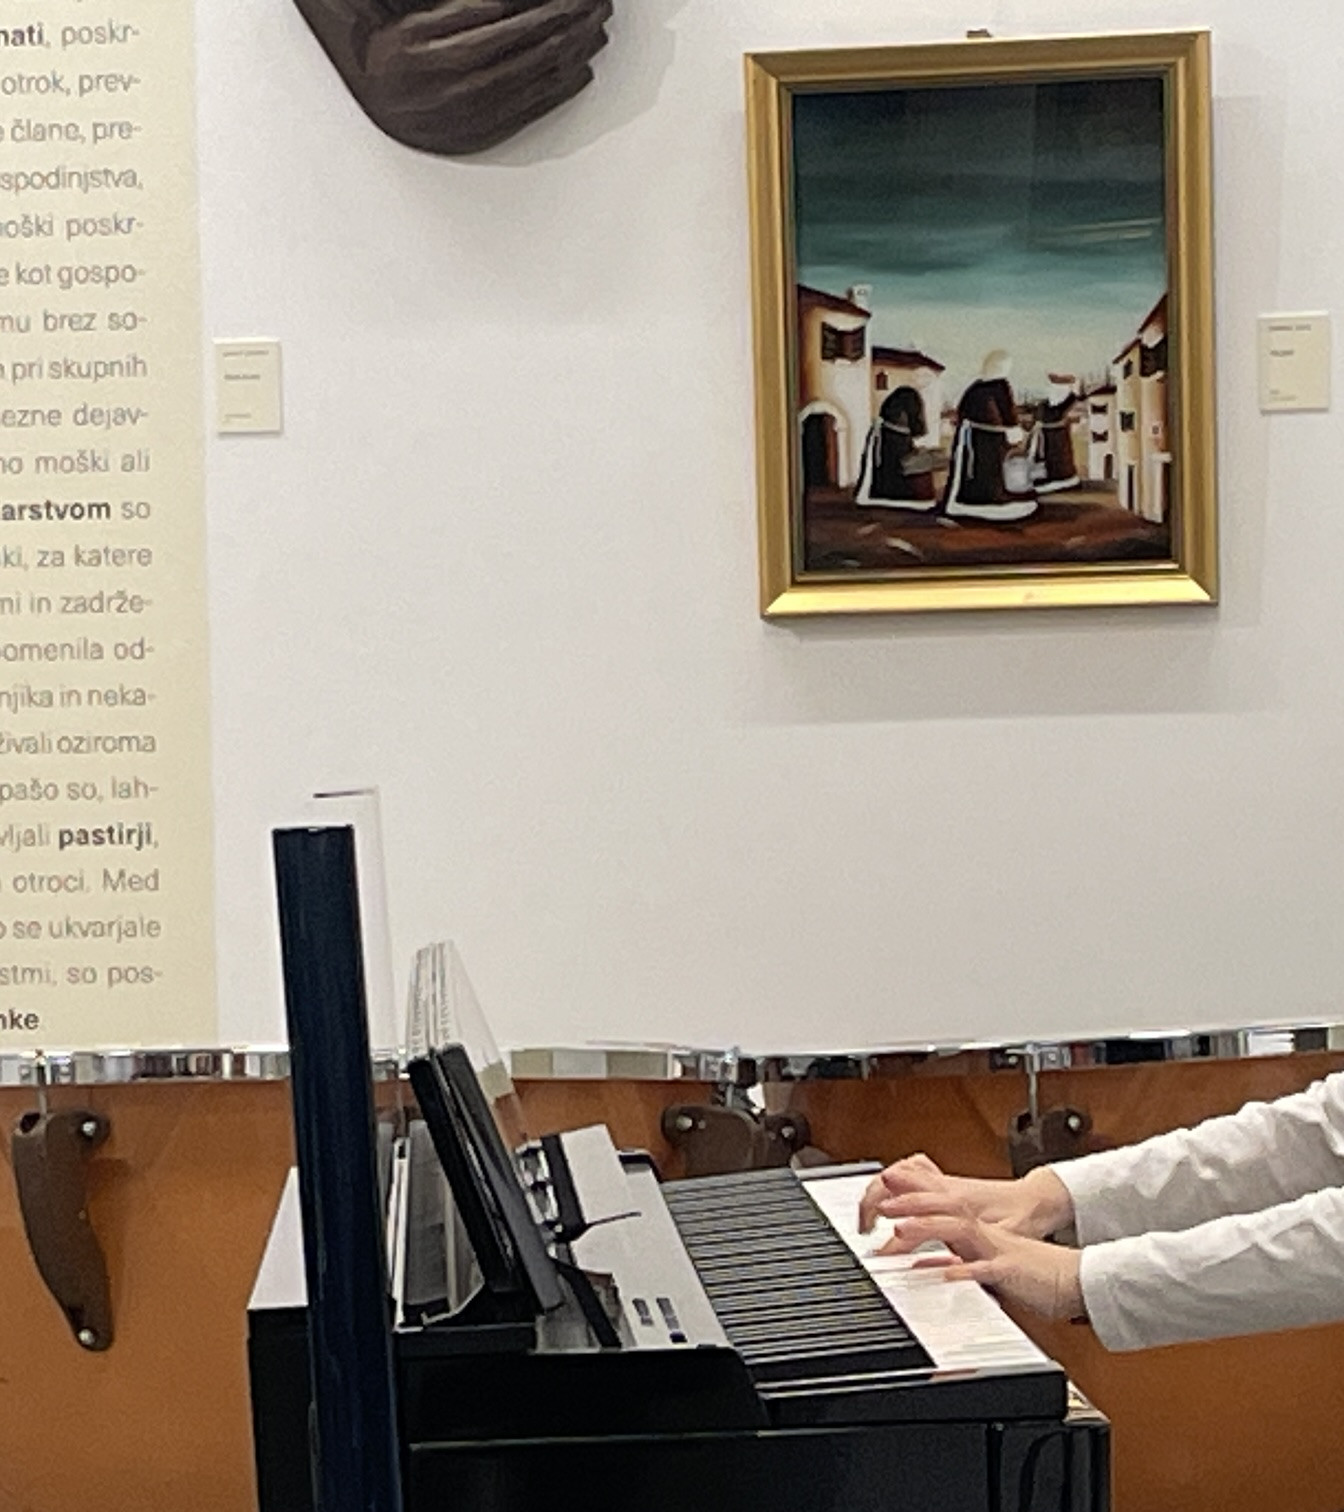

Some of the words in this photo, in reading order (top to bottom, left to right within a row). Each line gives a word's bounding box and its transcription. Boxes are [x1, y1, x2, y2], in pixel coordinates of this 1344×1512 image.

[60, 18, 140, 51] poskr-
[0, 69, 72, 97] otrok,
[77, 72, 141, 98] prev-
[10, 118, 87, 144] člane,
[91, 120, 142, 146] pre-
[65, 211, 144, 242] poskr-
[14, 261, 52, 286] kot
[56, 263, 146, 291] gospo-
[42, 308, 98, 333] brez
[107, 311, 148, 332] so-
[11, 357, 44, 386] pri
[47, 353, 148, 384] skupnih
[72, 401, 149, 431] dejav-
[34, 448, 110, 475] moški
[120, 449, 151, 473] ali
[120, 500, 152, 521] so
[36, 549, 66, 569] za
[73, 543, 153, 568] katere
[29, 592, 52, 615] in
[58, 589, 153, 615] zadrže-
[113, 636, 155, 661] od-
[59, 685, 83, 708] in
[86, 683, 156, 708] neka-
[56, 734, 157, 755] oziroma
[110, 775, 159, 800] lah-
[57, 821, 160, 852] pastirji,
[11, 869, 90, 894] otroci.
[101, 867, 160, 893] Med
[12, 920, 43, 940] se
[47, 915, 162, 944] ukvarjale
[66, 966, 98, 985] so
[106, 965, 163, 989] pos-
